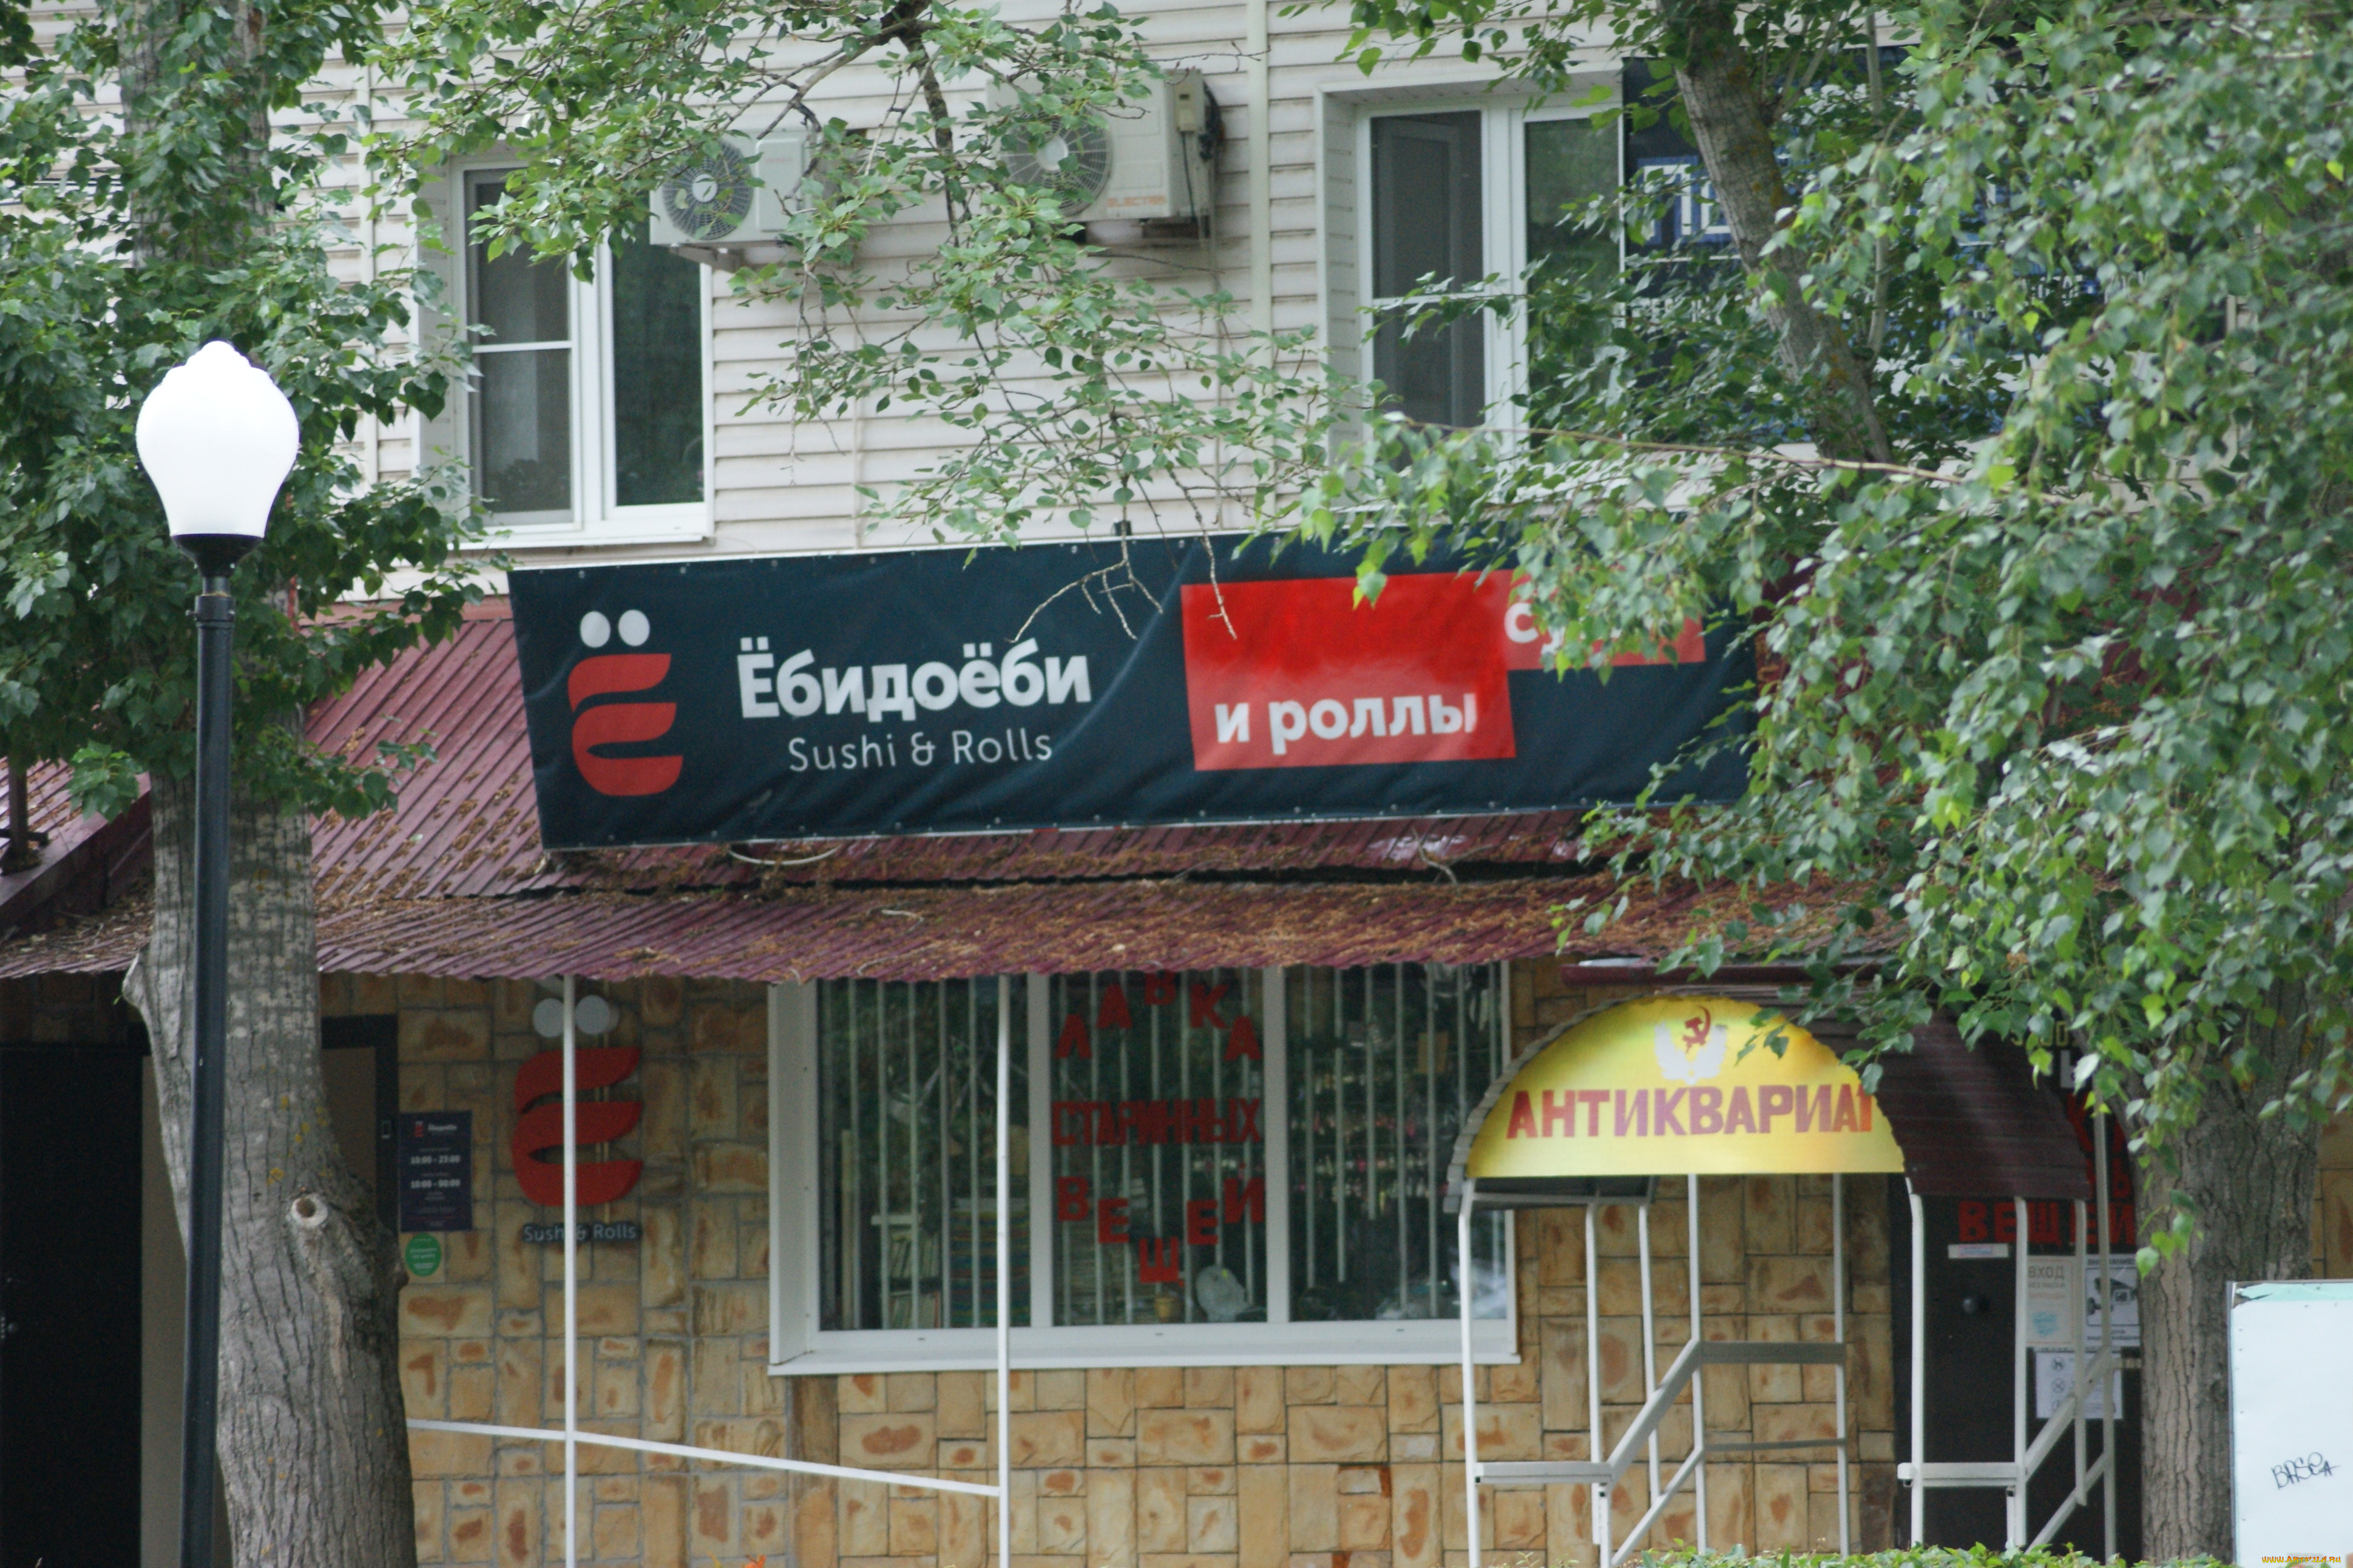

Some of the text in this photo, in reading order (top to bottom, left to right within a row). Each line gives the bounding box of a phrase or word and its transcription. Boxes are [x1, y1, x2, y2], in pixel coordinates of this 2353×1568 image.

[737, 636, 1091, 722] Ёбидоёби
[789, 728, 1052, 771] Sushi & Rolls
[1215, 693, 1477, 755] и роллы
[1052, 1098, 1261, 1146] СТАРИННЫХ
[1506, 1083, 1872, 1140] АНТИКВАРИАТ
[524, 1223, 572, 1242] Sush
[592, 1223, 637, 1239] Rolls
[1057, 1163, 1264, 1288] ВЕЩЕЙ
